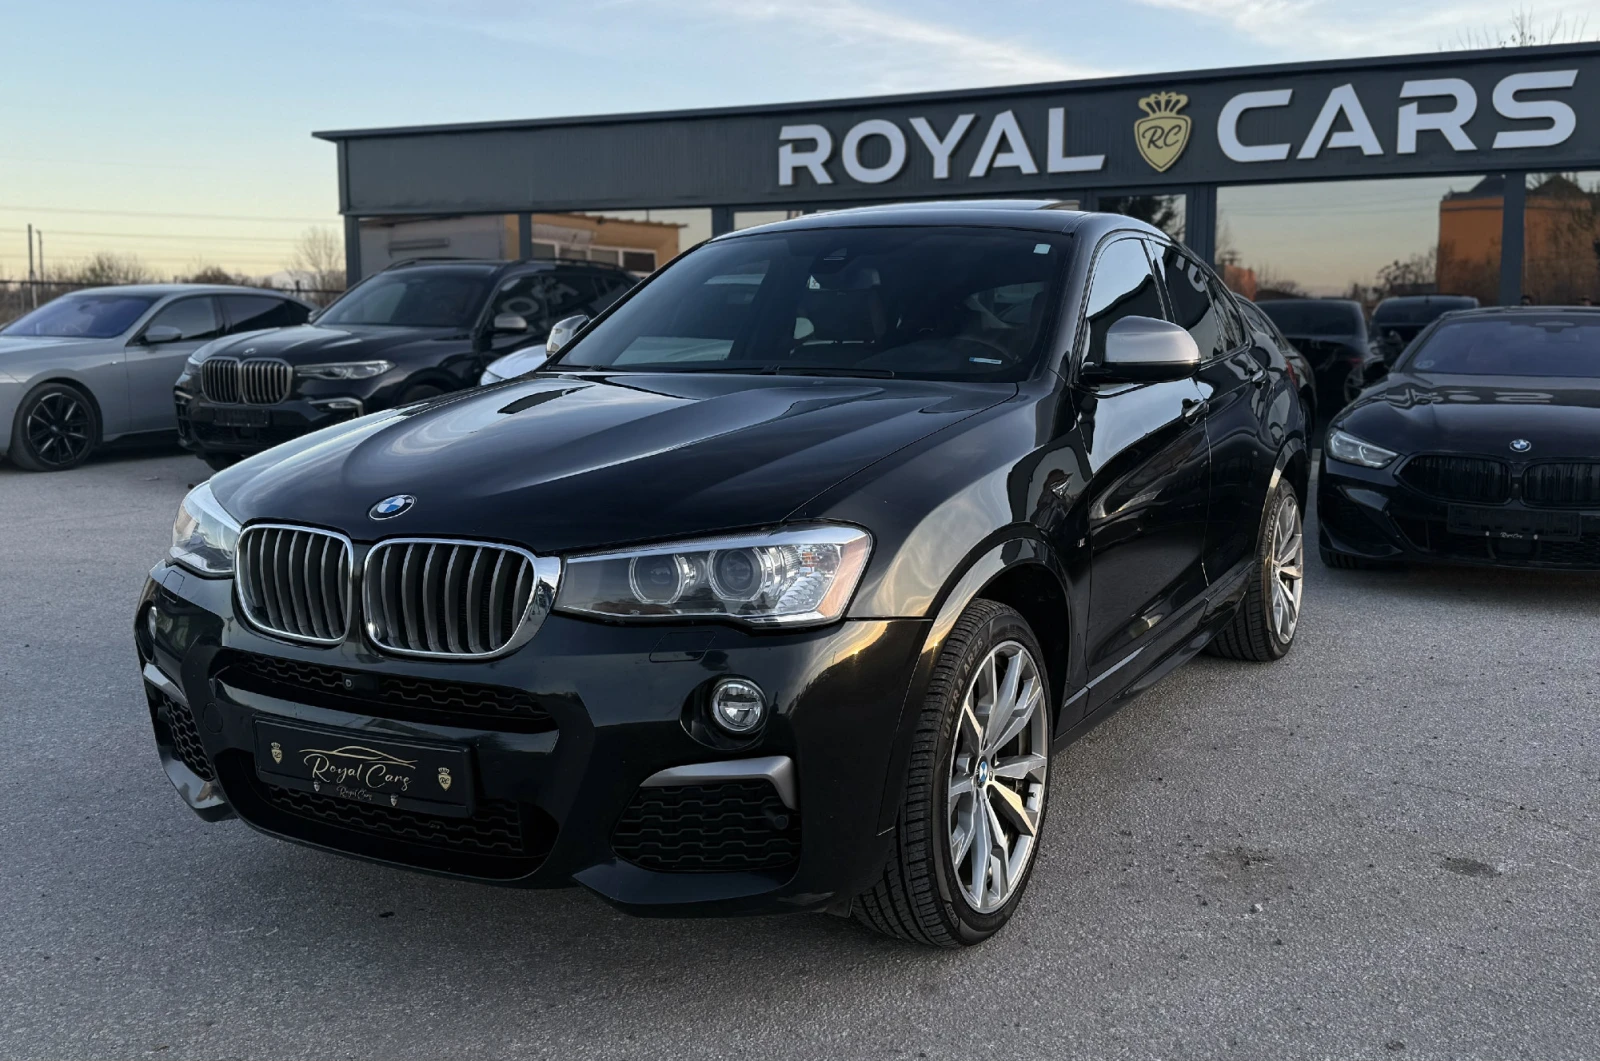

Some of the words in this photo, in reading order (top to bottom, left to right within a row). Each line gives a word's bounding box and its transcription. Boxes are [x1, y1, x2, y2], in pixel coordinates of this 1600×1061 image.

[778, 107, 1105, 186] ROYAL
[1141, 124, 1182, 149] RC
[1217, 69, 1579, 163] CARS
[944, 678, 964, 739] ULTRA
[303, 753, 362, 784] Royal
[365, 764, 413, 791] Cars
